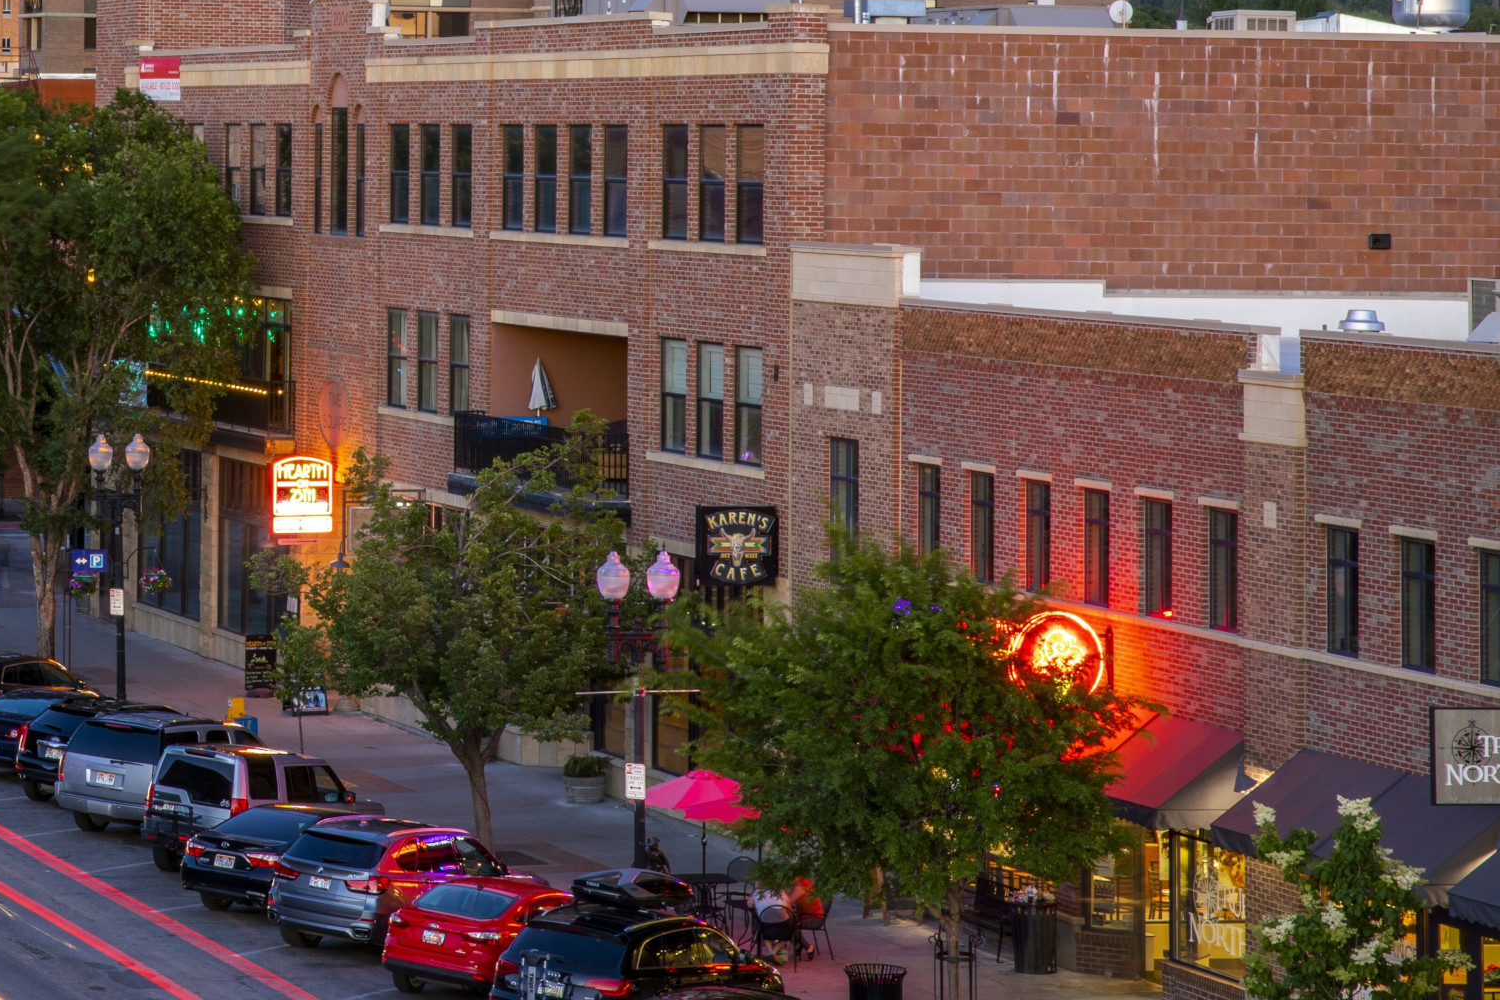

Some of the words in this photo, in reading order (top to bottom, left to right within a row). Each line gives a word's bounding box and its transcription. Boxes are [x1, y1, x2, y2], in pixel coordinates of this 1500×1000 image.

[328, 391, 342, 408] THE
[323, 415, 347, 432] SQUARE
[277, 464, 327, 479] HEARTH
[290, 488, 316, 502] 25TH
[707, 511, 769, 530] KAREN'S
[715, 563, 762, 581] CAFE
[1444, 763, 1500, 786] NOR
